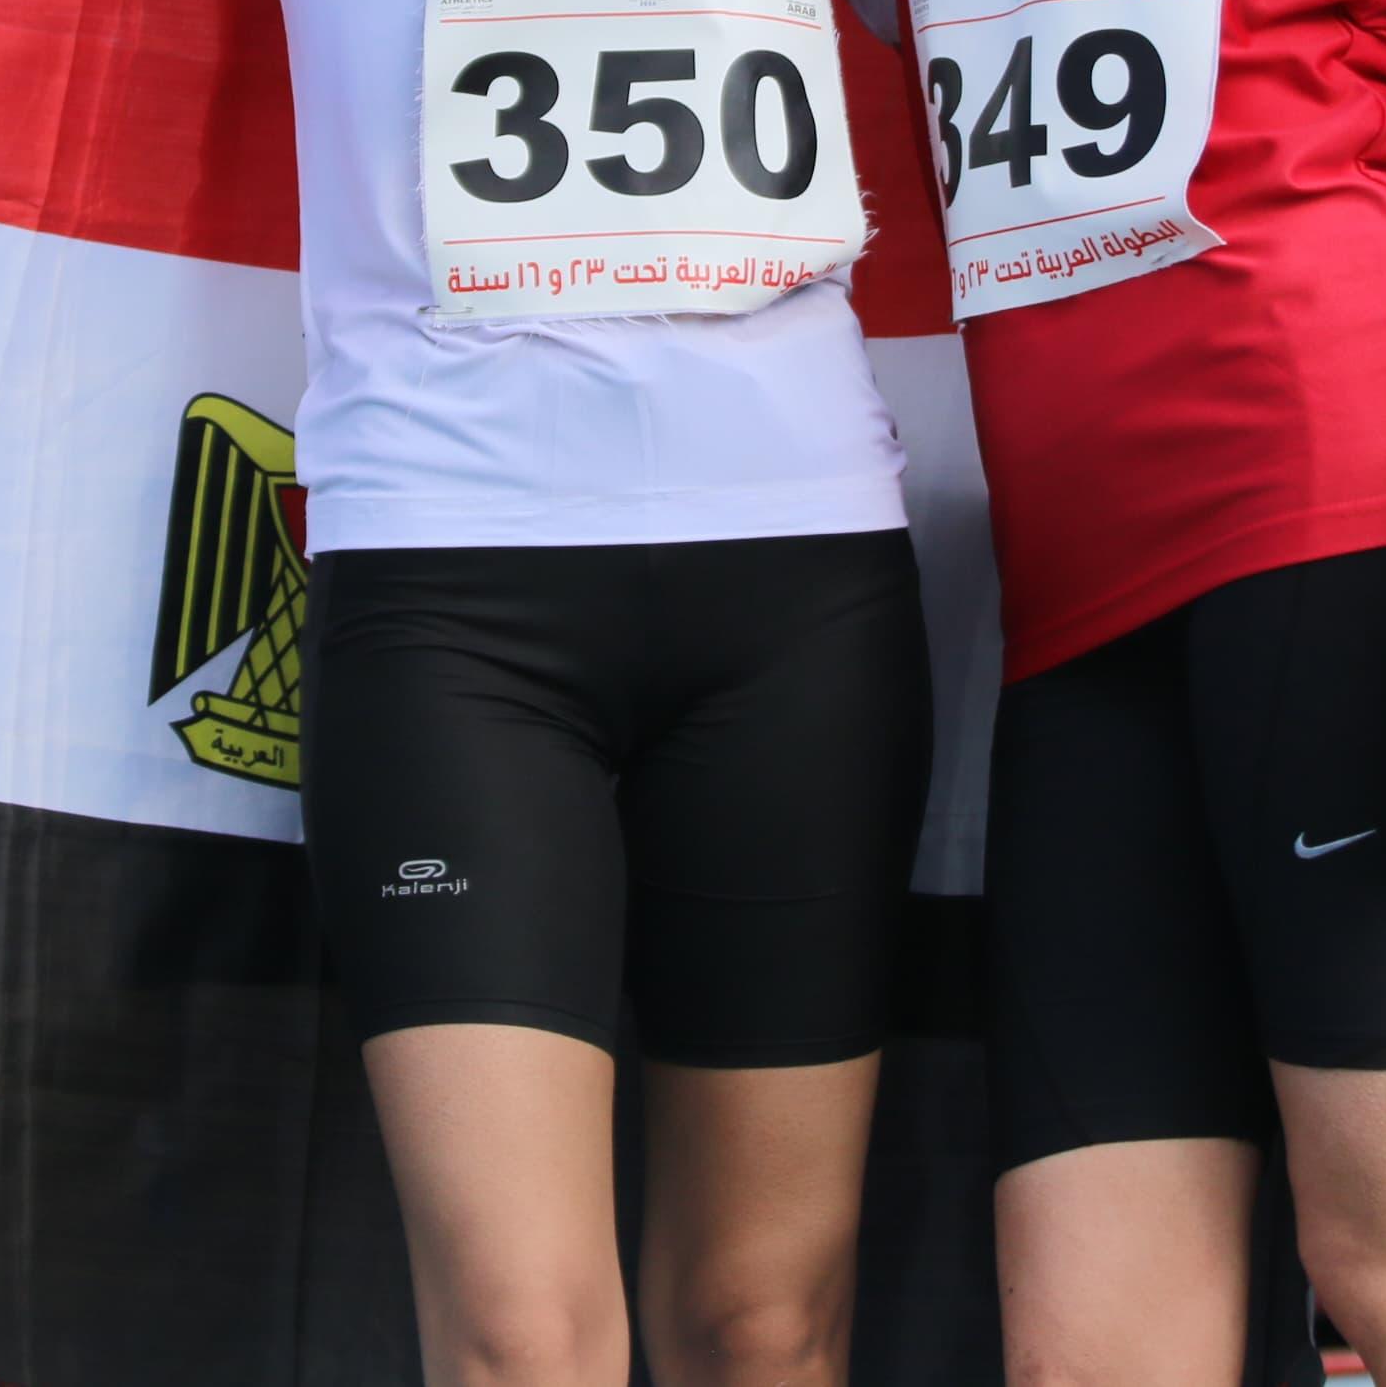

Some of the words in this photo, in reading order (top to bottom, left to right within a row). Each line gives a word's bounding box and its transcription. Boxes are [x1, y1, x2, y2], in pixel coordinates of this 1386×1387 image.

[787, 2, 817, 17] ARAB
[449, 48, 818, 203] 350
[927, 27, 1167, 210] 349
[1103, 219, 1185, 258] البطولة
[570, 258, 605, 286] ٢٣
[613, 256, 667, 284] تحت
[676, 255, 757, 291] العربية
[995, 251, 1032, 283] تحت
[1036, 236, 1103, 280] العربية
[448, 266, 510, 293] سنة
[211, 728, 284, 768] العربية
